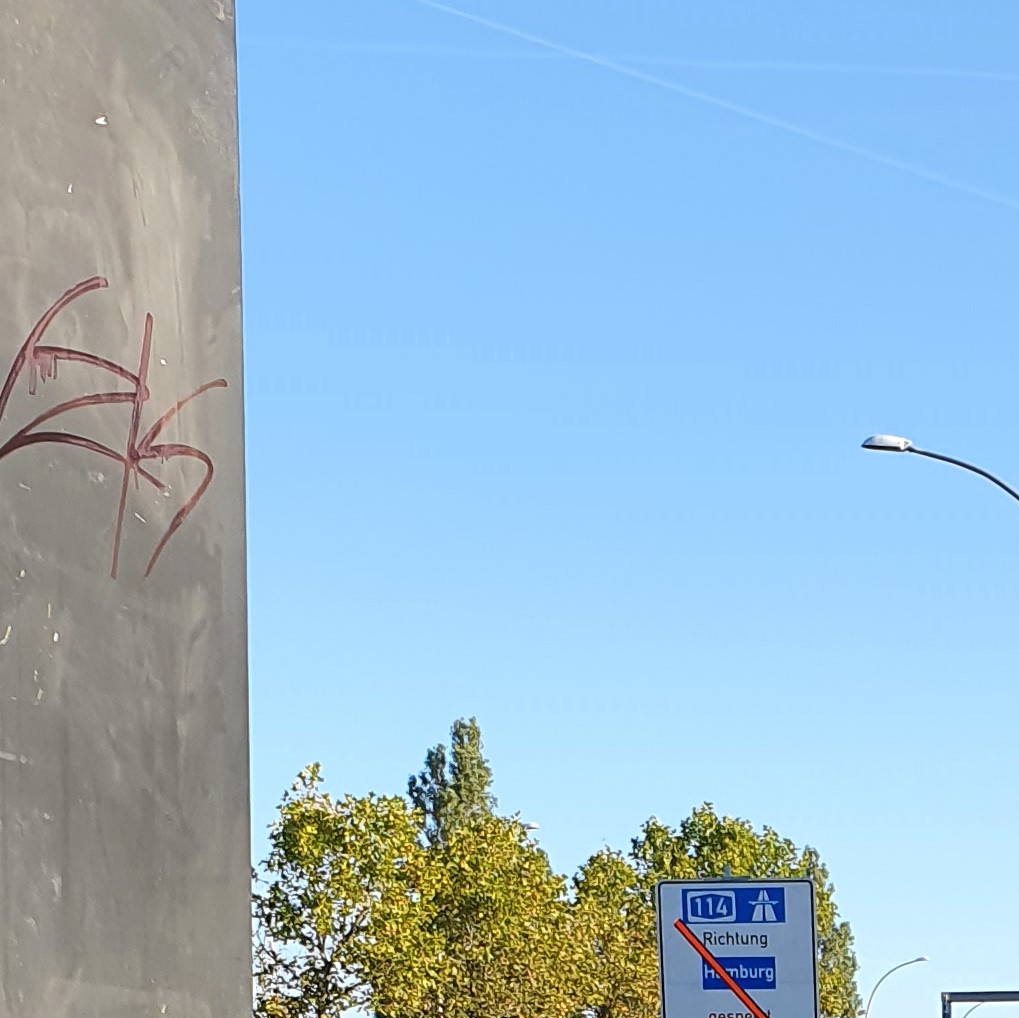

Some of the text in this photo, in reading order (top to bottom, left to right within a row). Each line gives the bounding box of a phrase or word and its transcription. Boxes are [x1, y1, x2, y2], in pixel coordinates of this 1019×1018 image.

[695, 896, 729, 917] 114
[703, 931, 769, 949] Richtung
[703, 964, 775, 983] Hmburg
